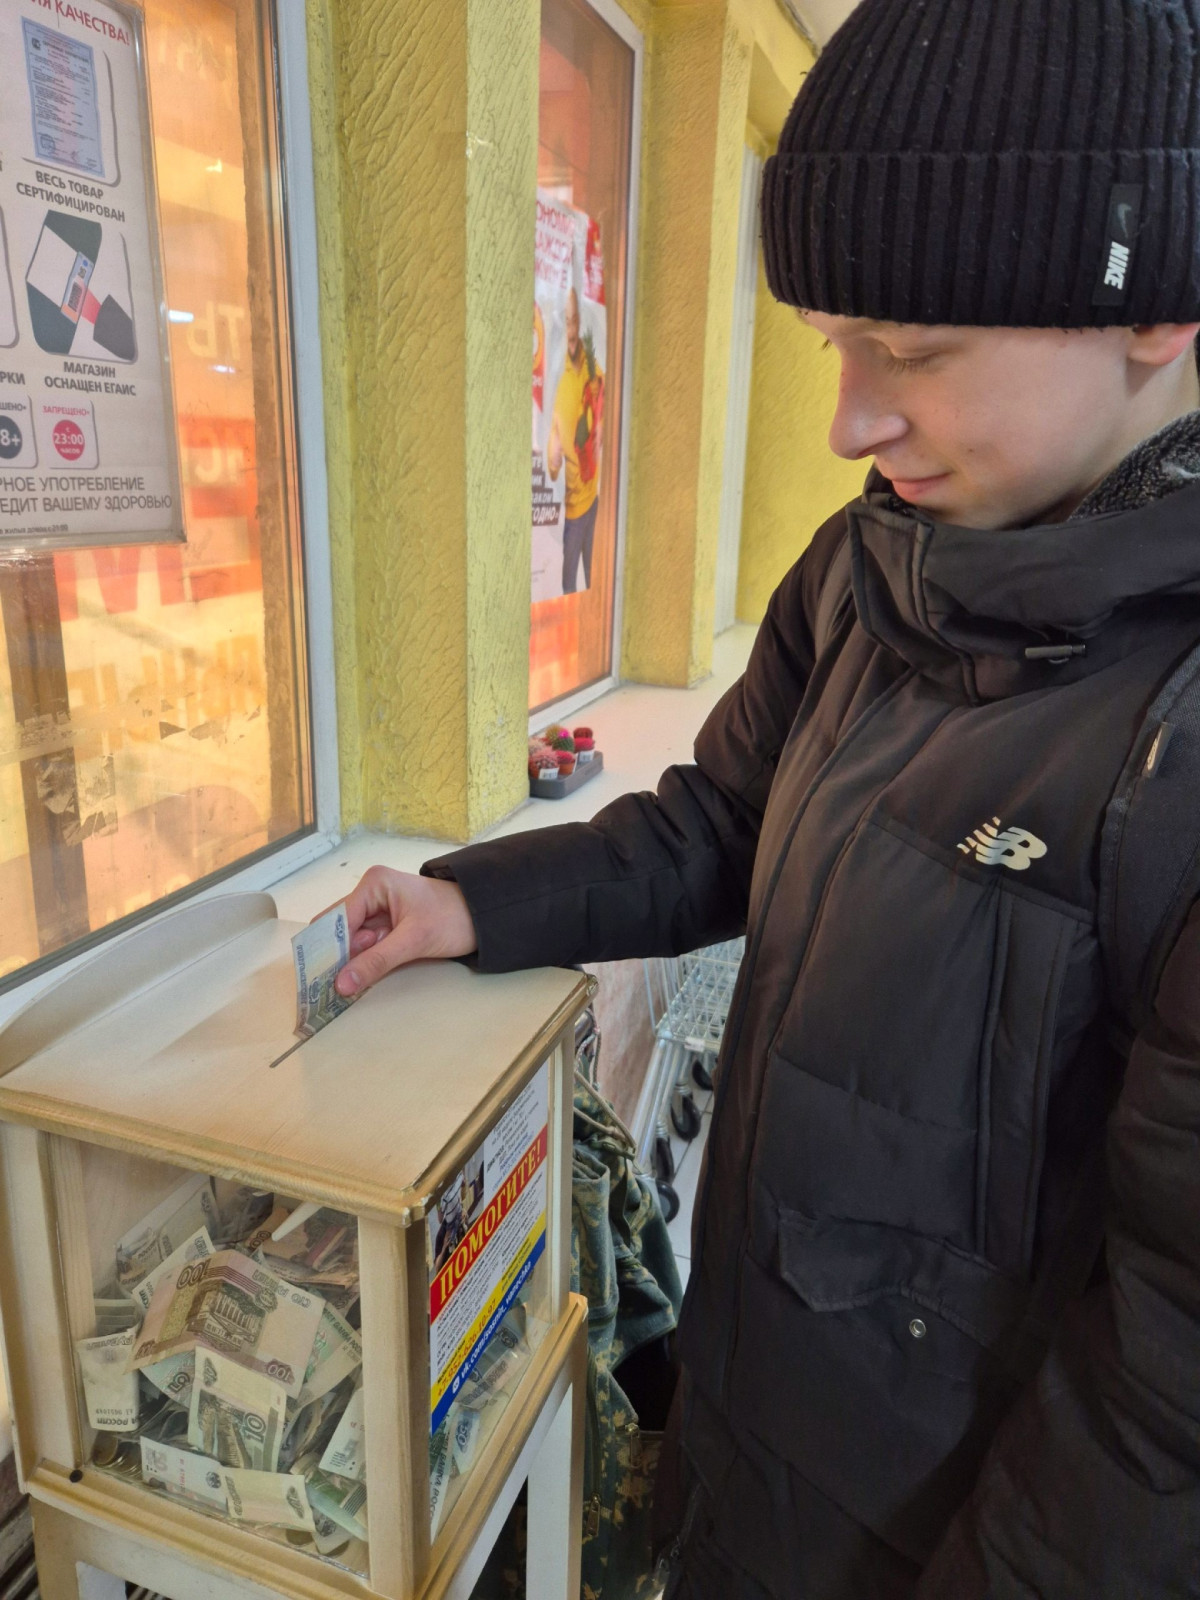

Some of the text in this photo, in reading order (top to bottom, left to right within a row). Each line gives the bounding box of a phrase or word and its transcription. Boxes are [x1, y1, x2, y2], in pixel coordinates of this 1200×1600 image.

[55, 0, 131, 46] КАЧЕСТВА!
[35, 171, 104, 199] ВЕСЬ ТОВАР
[16, 182, 126, 223] СЕРТИФИЦИРОВАН
[1103, 241, 1130, 290] NIKE
[0, 371, 26, 385] РКИ
[63, 361, 116, 378] МАГАЗИН
[44, 376, 137, 396] ОСНАЩЕН ЕГАИС
[0, 402, 27, 412] ШЕНО
[0, 428, 21, 446] 8+
[54, 433, 84, 445] 23:00
[38, 477, 145, 492] УПОТРЕБЛЕНИЕ
[0, 495, 172, 516] ЕДИТ ВАШЕМУ ЗДОРОВЬЮ
[440, 1138, 542, 1305] ПОМОГИТЕ!
